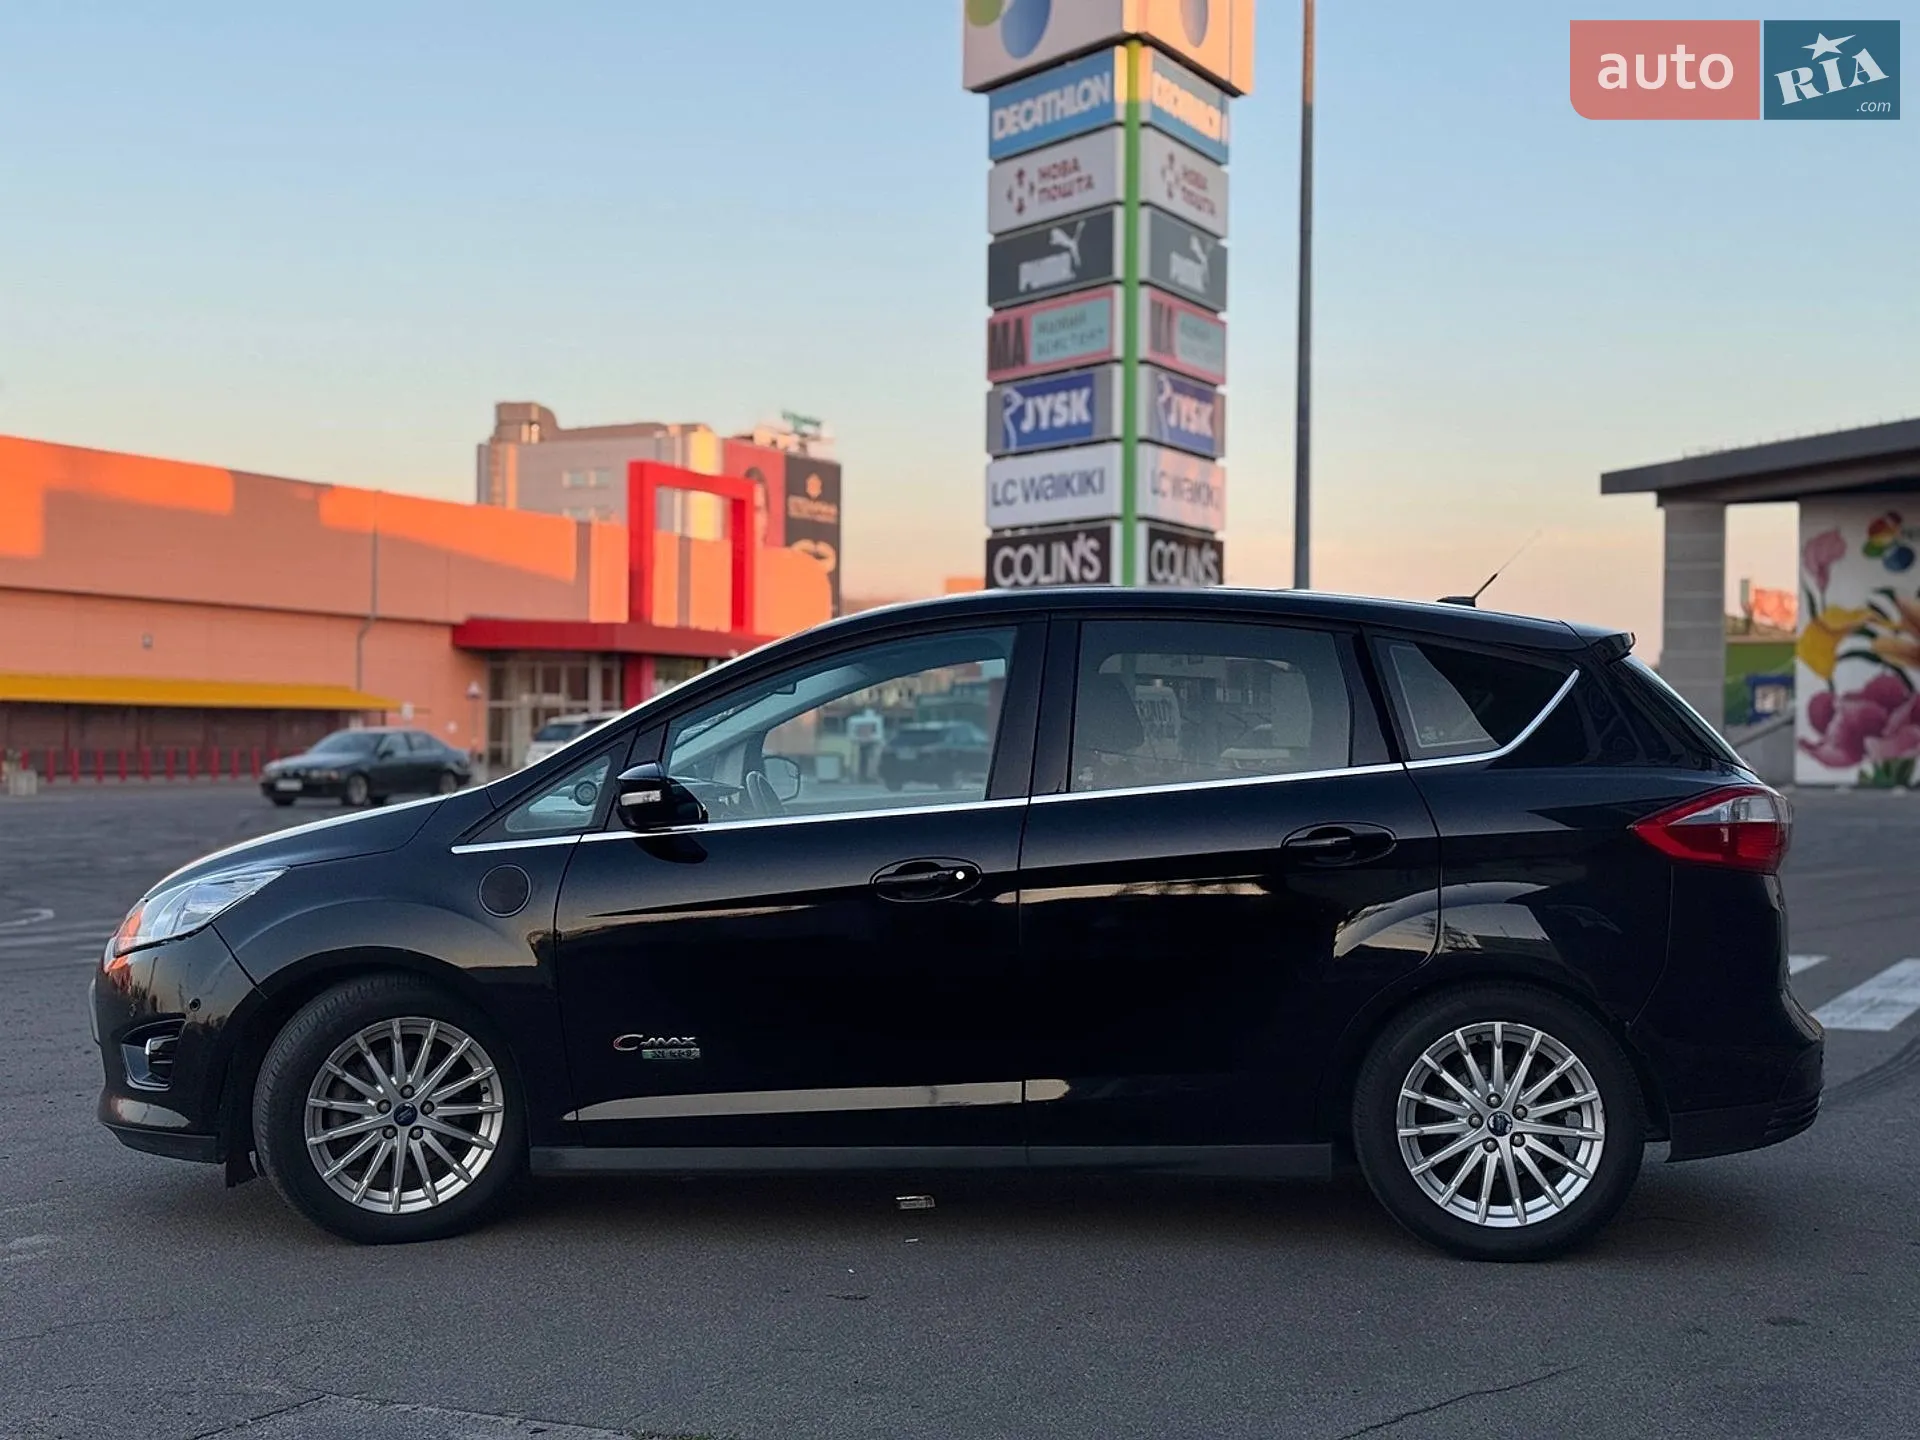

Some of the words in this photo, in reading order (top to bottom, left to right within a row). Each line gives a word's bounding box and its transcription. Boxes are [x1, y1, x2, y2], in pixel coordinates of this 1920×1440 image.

[992, 71, 1111, 140] DECATHLON
[1020, 387, 1093, 433] JYSK
[991, 478, 1018, 508] LC
[993, 532, 1101, 587] COLIN'S
